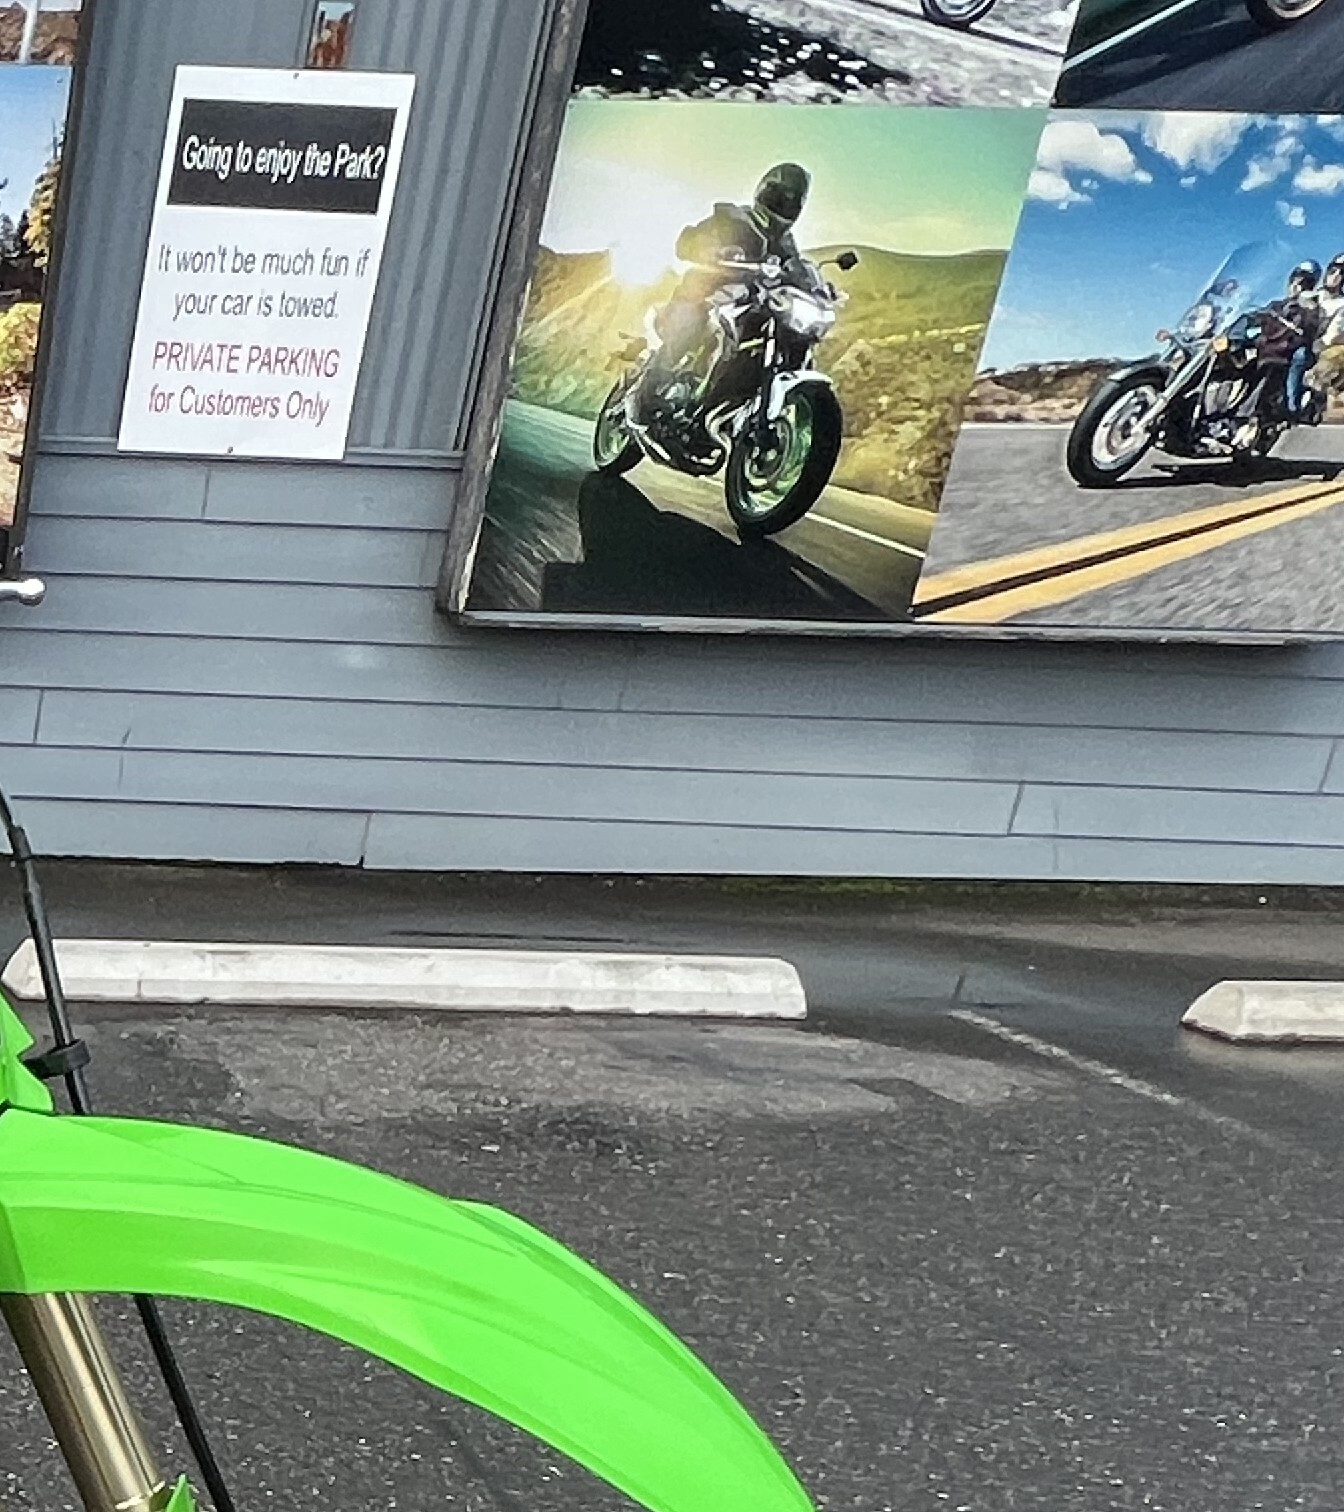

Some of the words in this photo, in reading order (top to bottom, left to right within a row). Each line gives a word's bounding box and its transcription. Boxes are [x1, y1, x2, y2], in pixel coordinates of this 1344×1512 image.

[182, 134, 234, 180] Going
[234, 140, 253, 173] to
[254, 140, 302, 183] enjoy
[303, 143, 331, 177] the
[332, 143, 386, 179] Park?
[158, 245, 171, 272] It
[176, 245, 227, 273] won't
[231, 246, 256, 273] be
[261, 248, 314, 276] much
[319, 247, 348, 276] fun
[355, 249, 371, 277] if
[172, 292, 218, 321] your
[220, 294, 253, 316] car
[256, 291, 273, 317] is
[278, 290, 339, 318] towed.
[152, 341, 242, 373] PRIVATE
[247, 345, 340, 377] PARKING
[148, 383, 174, 413] for
[180, 385, 281, 418] Customers
[286, 390, 330, 427] Only
